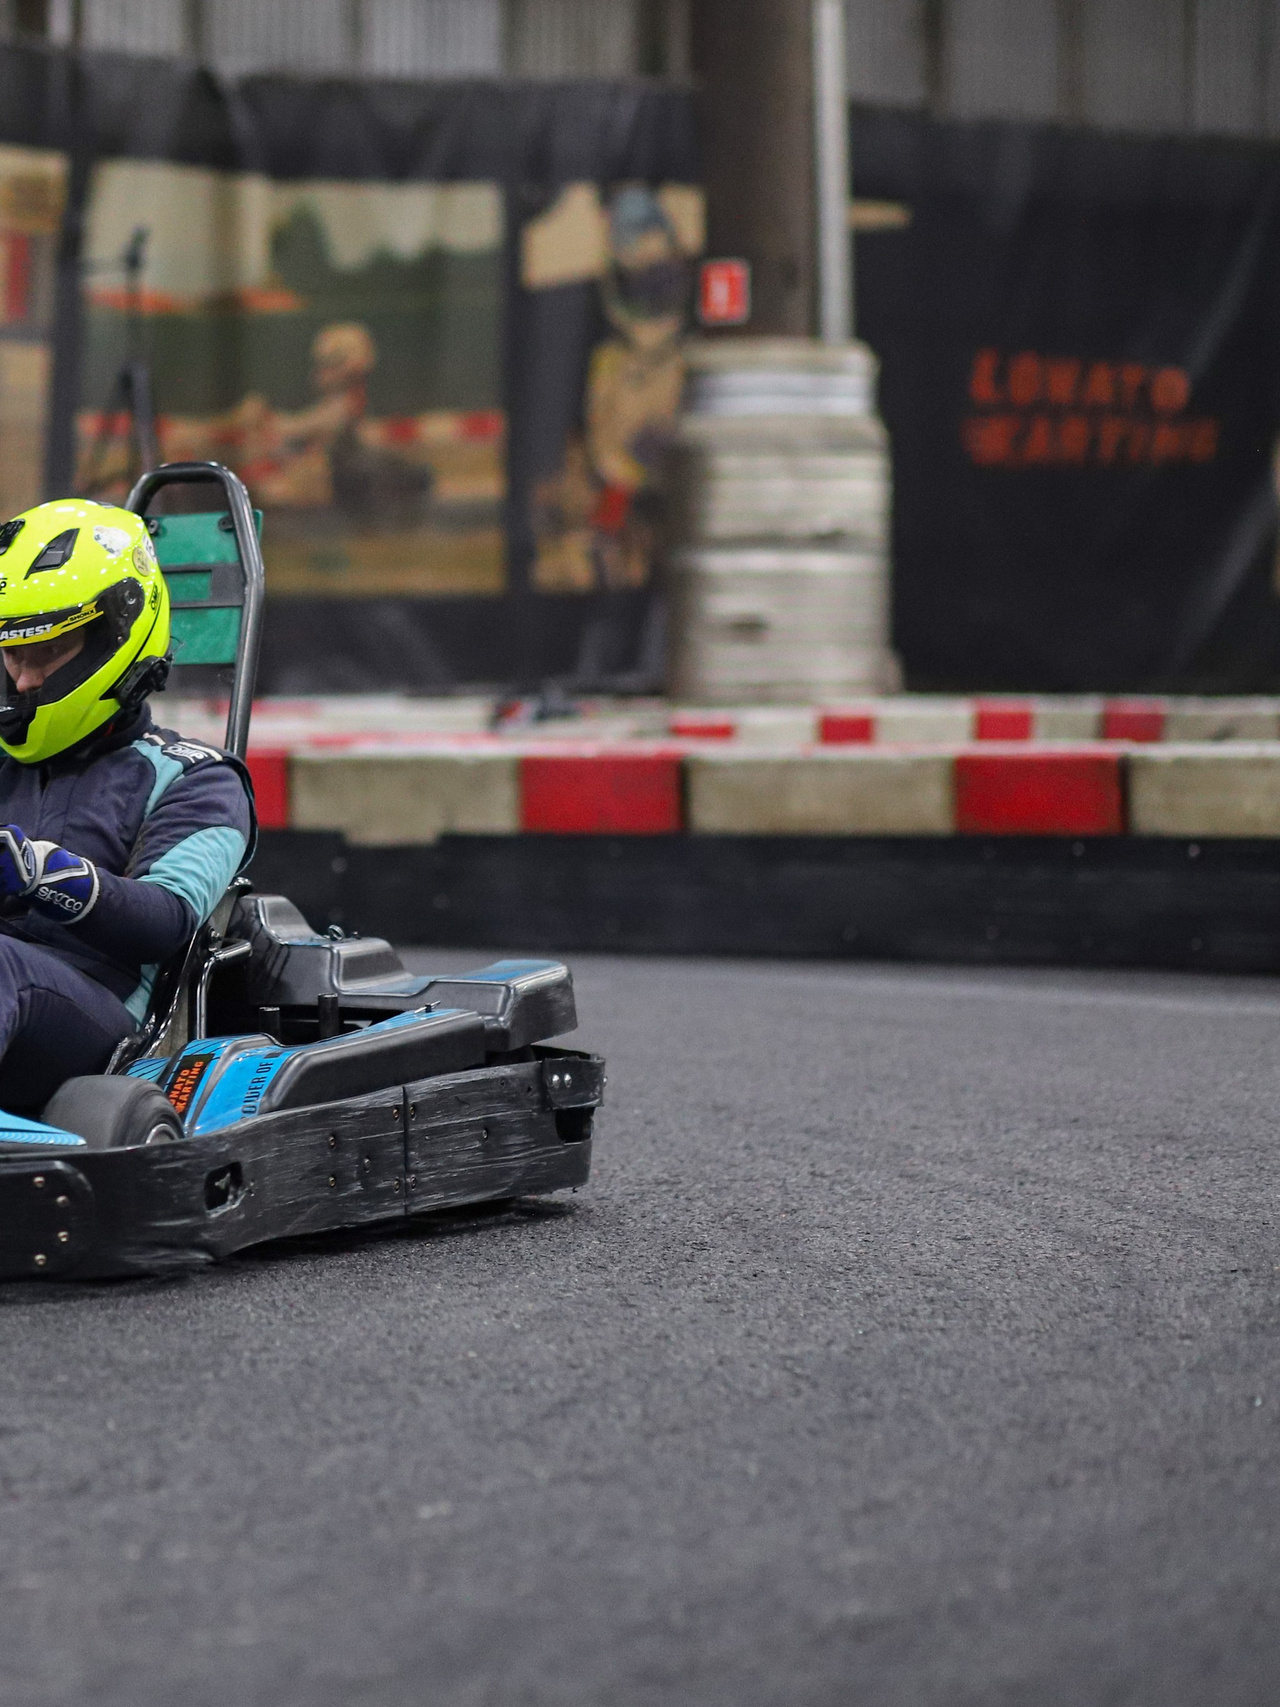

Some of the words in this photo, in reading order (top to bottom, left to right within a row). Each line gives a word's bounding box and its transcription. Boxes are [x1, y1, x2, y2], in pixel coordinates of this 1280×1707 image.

[38, 886, 83, 911] sparco
[177, 1061, 204, 1113] KARTING
[241, 1077, 266, 1119] OWER
